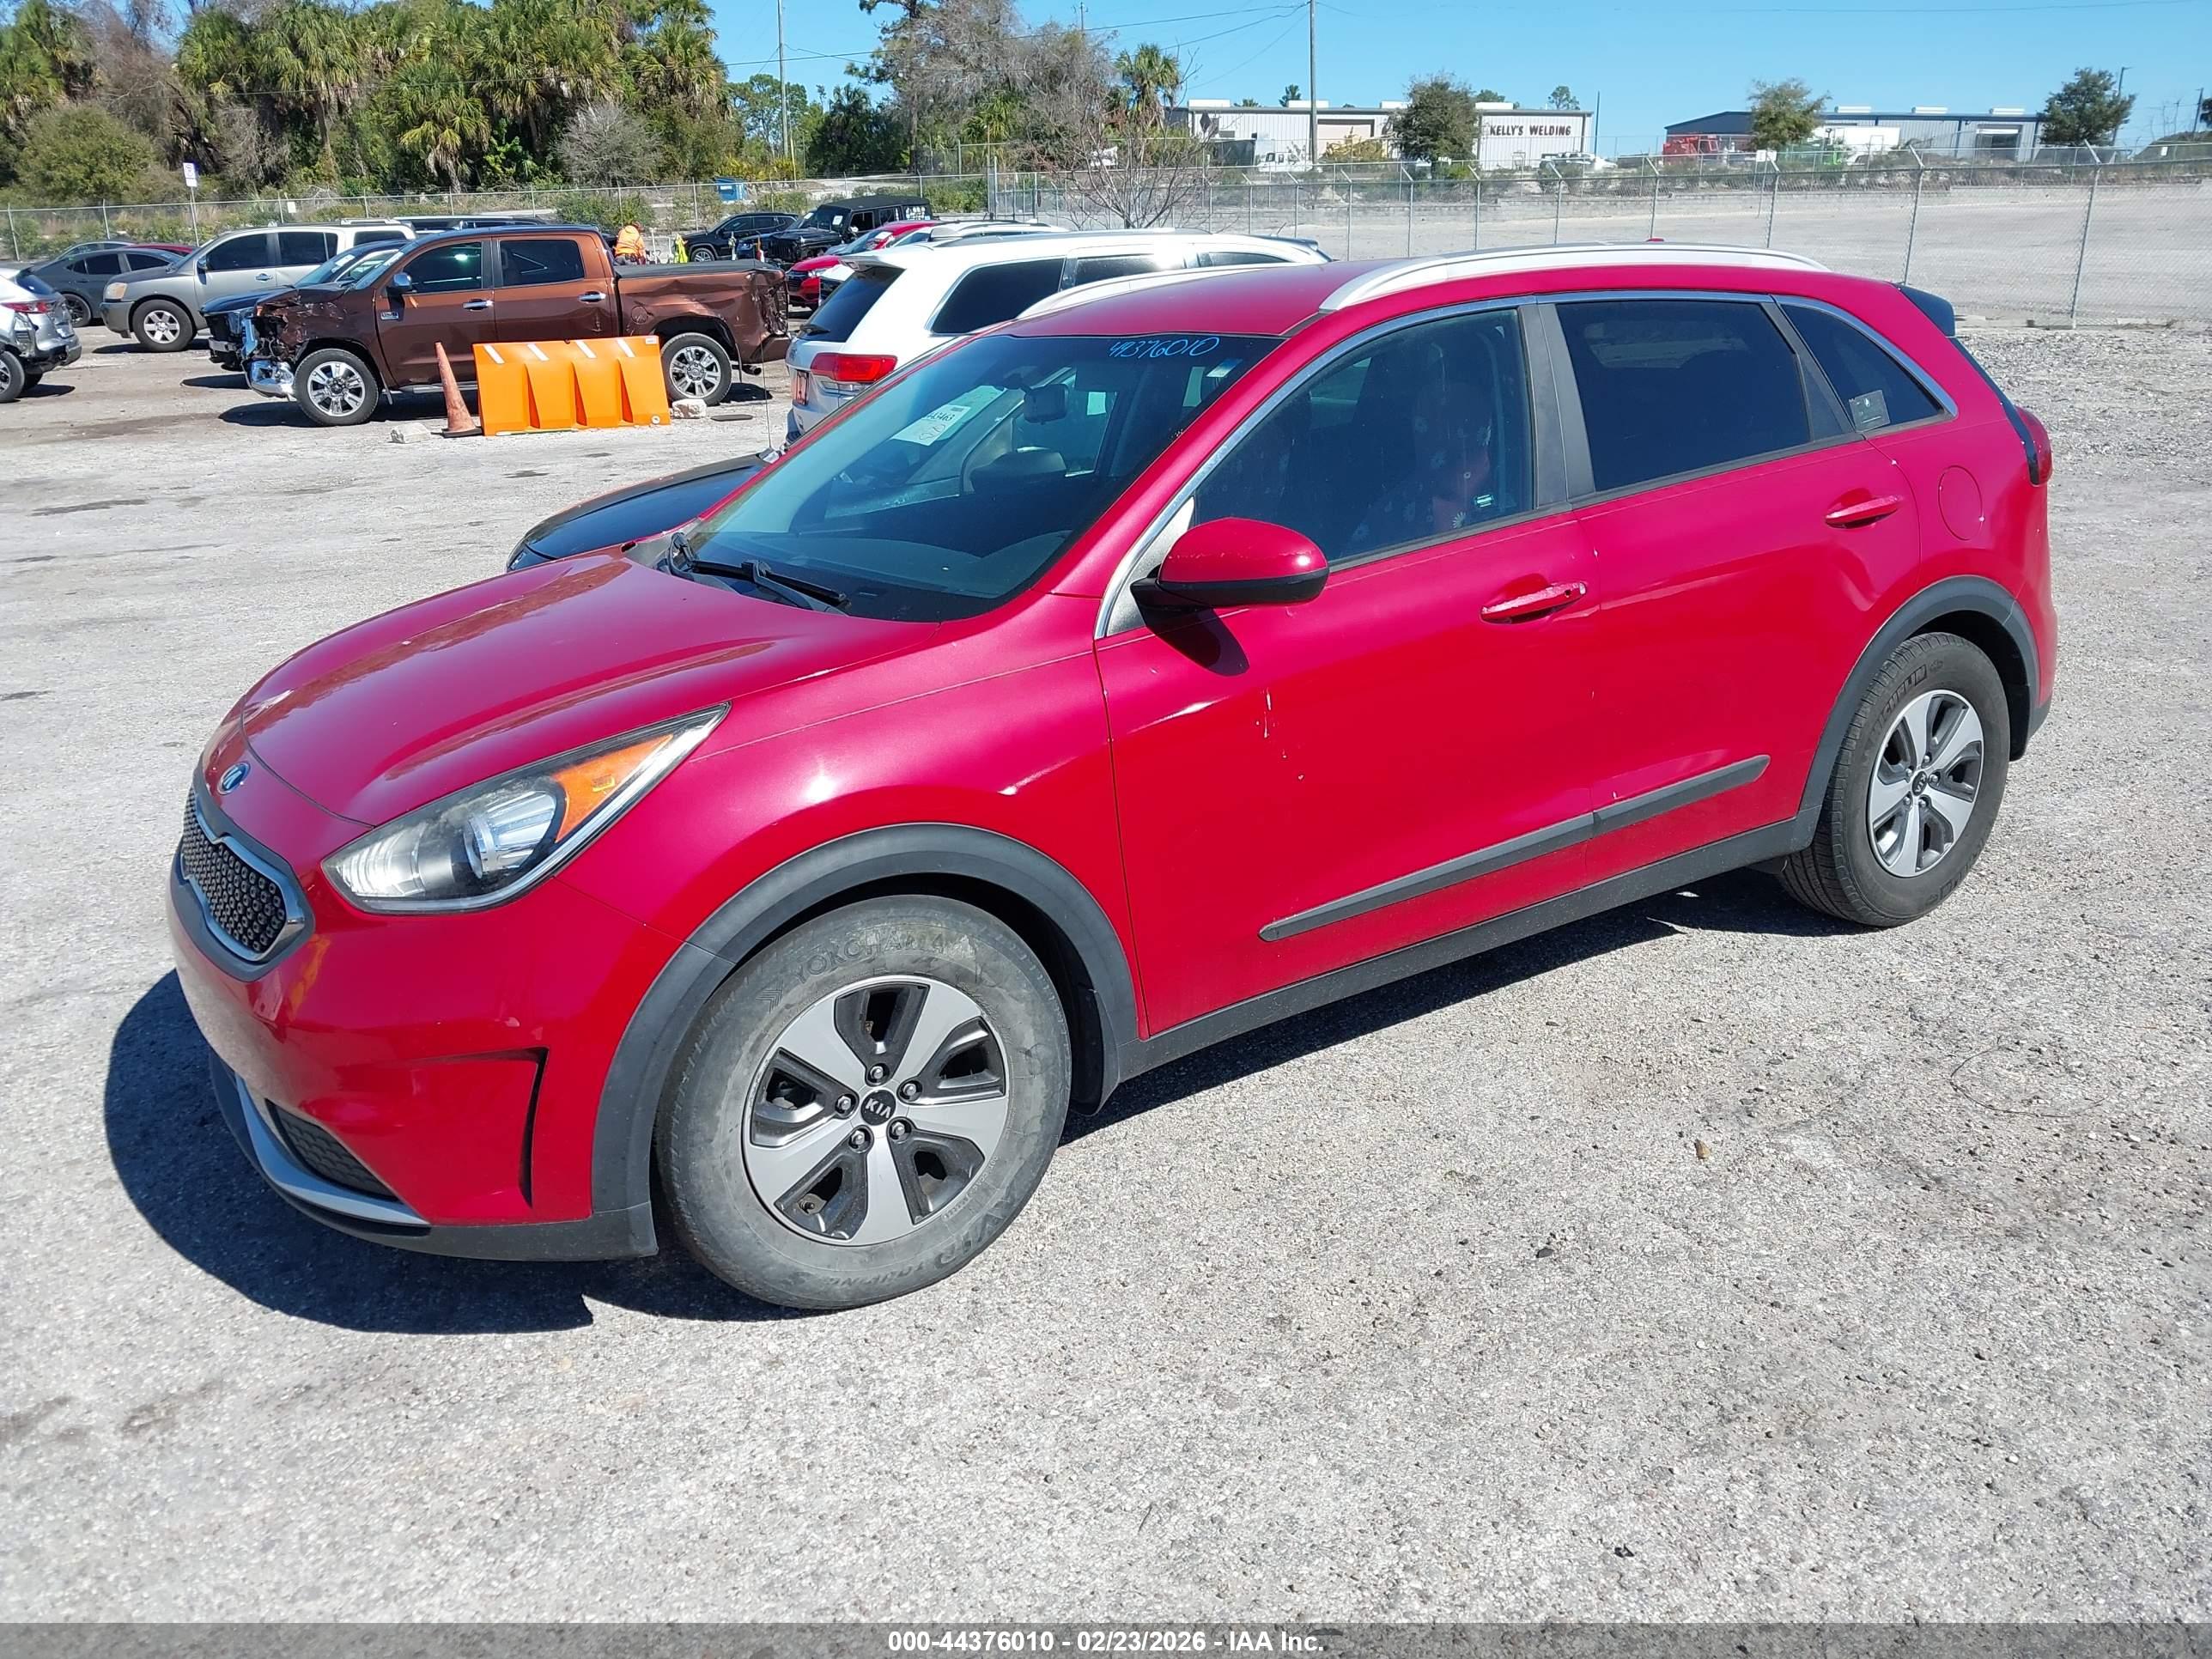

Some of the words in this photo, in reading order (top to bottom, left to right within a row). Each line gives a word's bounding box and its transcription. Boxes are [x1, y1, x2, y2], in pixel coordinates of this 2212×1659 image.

[1490, 125, 1524, 136] KELLY'S
[1529, 125, 1571, 136] WELDING
[1868, 664, 1928, 745] ICHELIN
[1915, 774, 1926, 793] KIA
[865, 1098, 891, 1119] KIA
